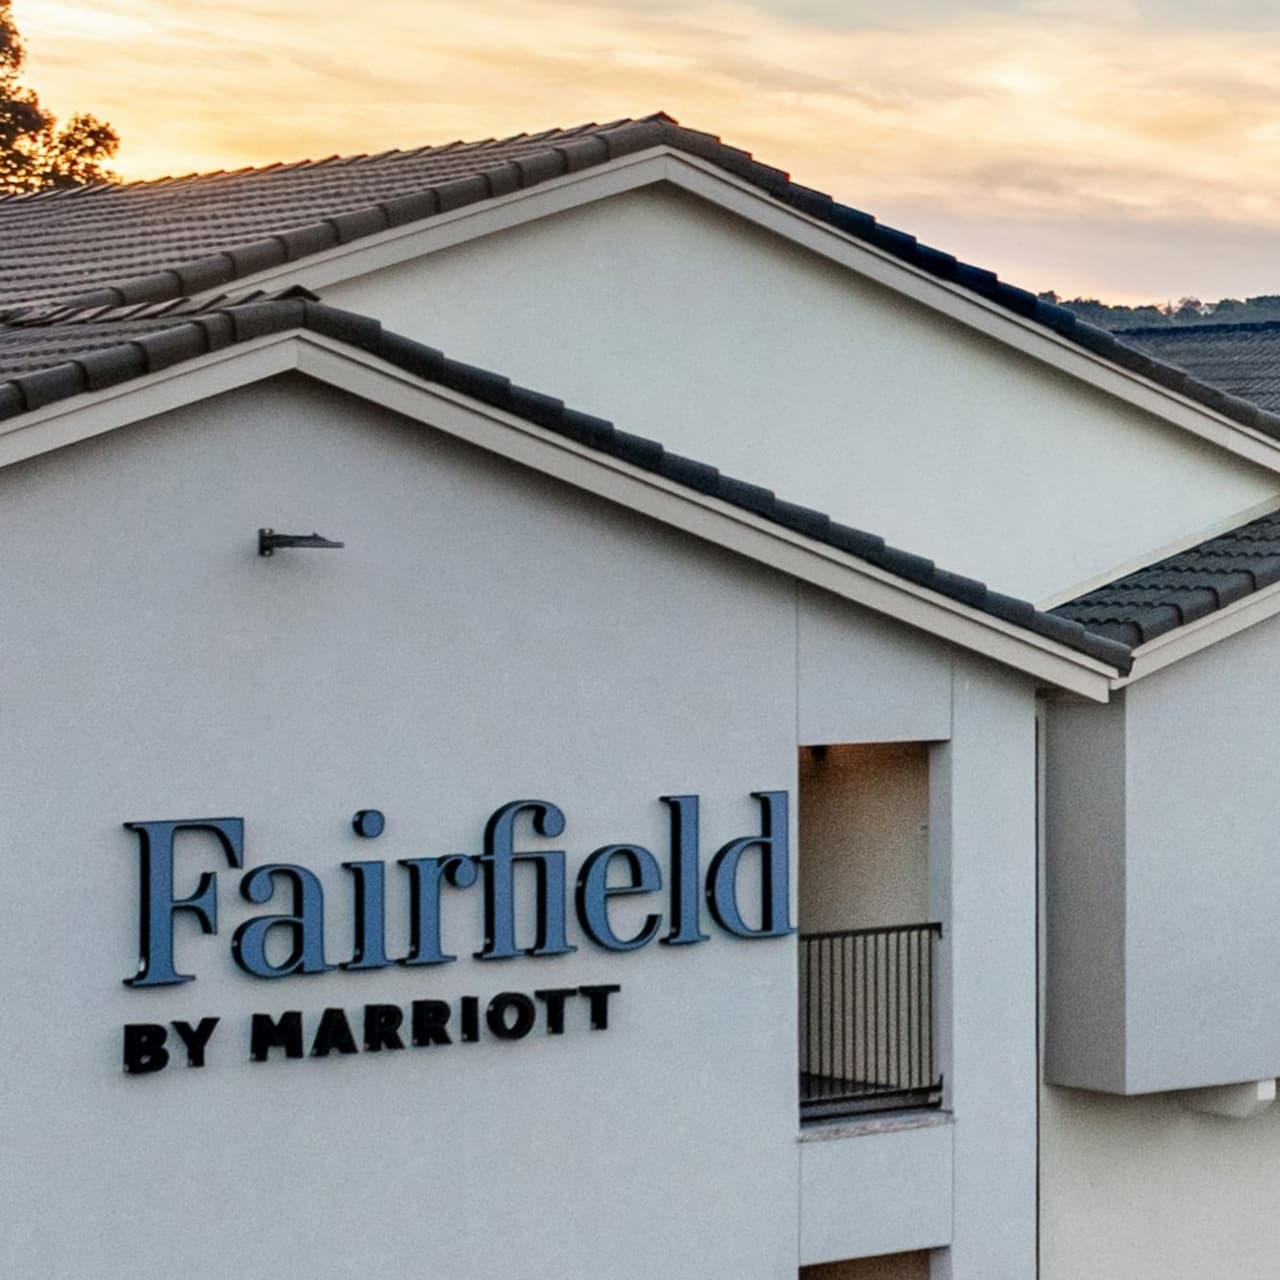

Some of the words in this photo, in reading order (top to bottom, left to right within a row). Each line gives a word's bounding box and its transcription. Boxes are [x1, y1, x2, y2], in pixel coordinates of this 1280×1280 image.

[122, 790, 797, 987] Fairfield
[123, 1017, 220, 1074] BY
[249, 984, 621, 1062] MARRIOTT
